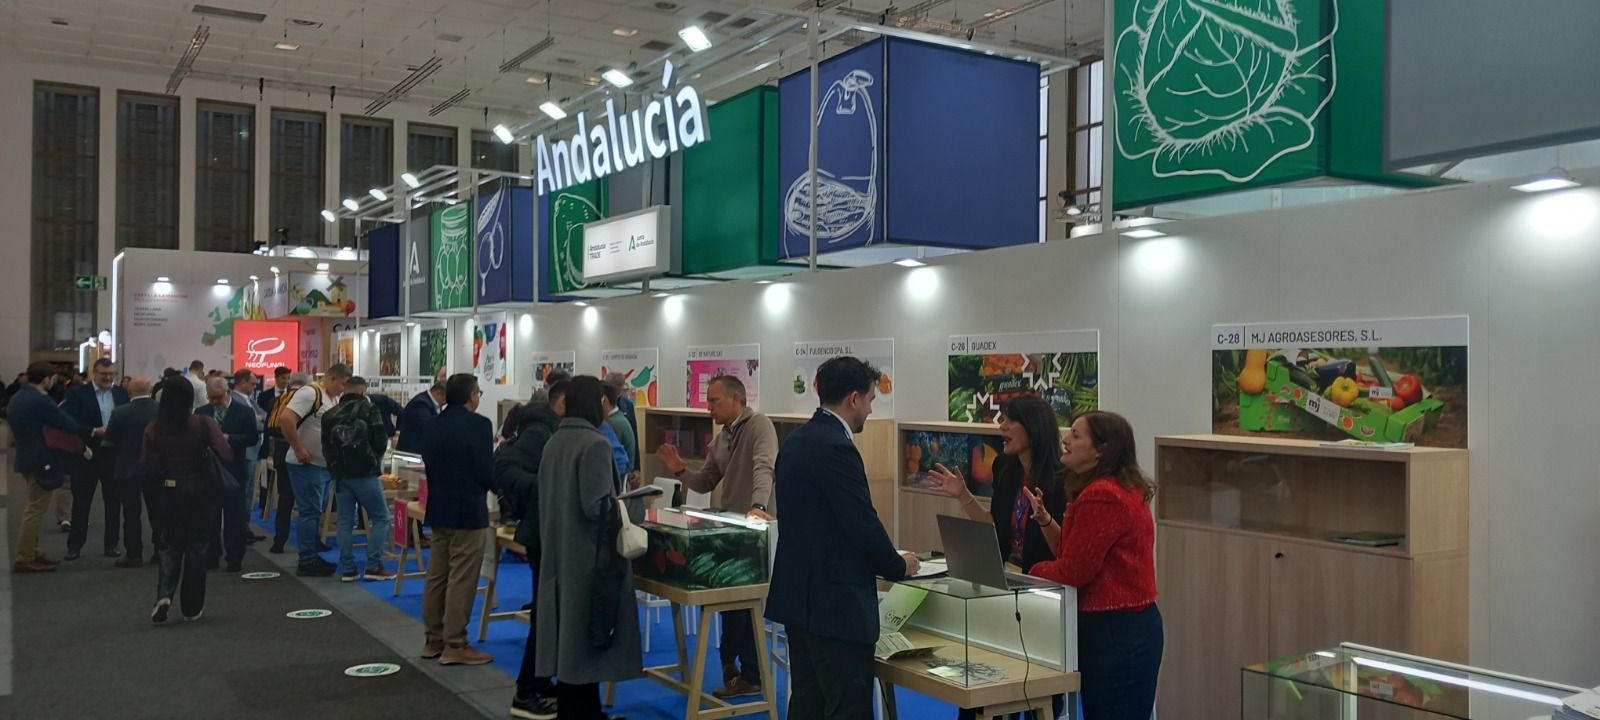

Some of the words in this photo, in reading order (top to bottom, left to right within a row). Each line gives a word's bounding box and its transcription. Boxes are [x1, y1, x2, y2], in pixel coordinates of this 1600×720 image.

[536, 59, 705, 196] Andalucía
[1217, 333, 1240, 344] C-28
[1251, 332, 1266, 344] MJ
[1267, 329, 1358, 344] AGROASESORES,
[1360, 329, 1383, 342] S.L.
[1308, 398, 1321, 413] mj
